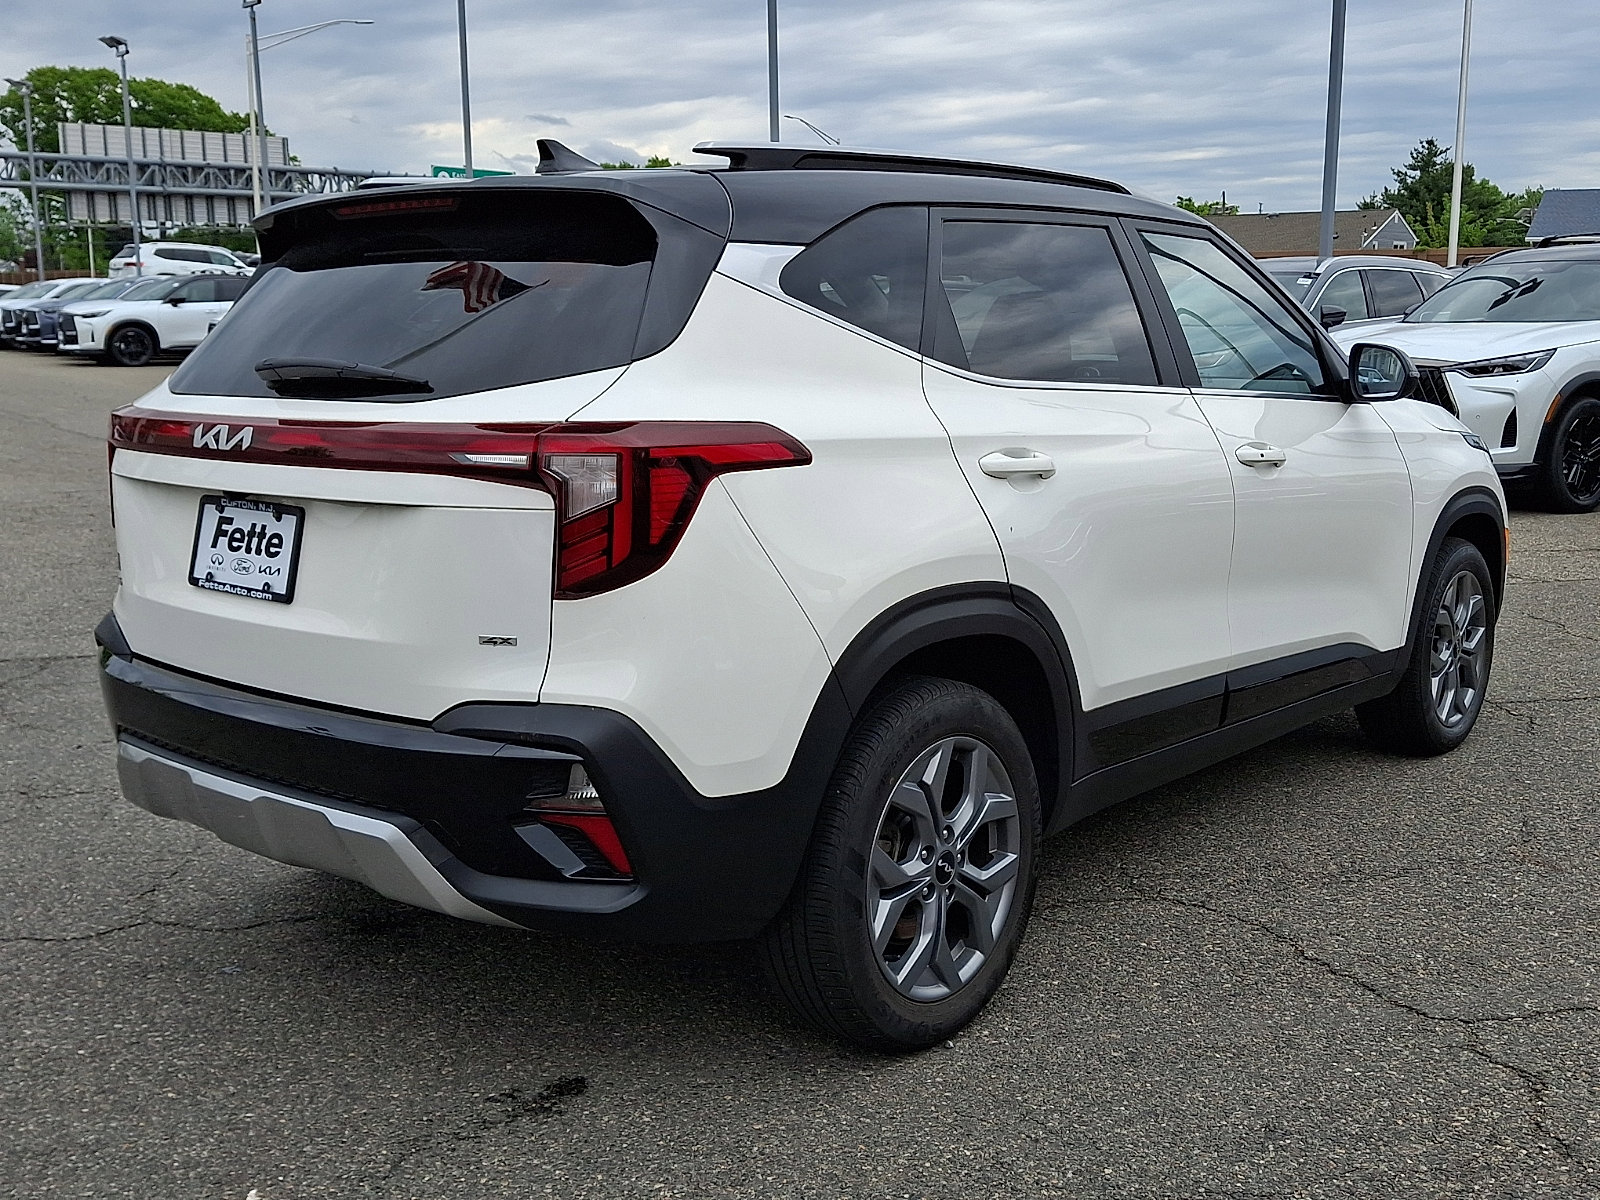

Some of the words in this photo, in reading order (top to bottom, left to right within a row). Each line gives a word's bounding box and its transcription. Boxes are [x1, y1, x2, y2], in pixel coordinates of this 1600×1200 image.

[193, 423, 254, 451] KIA
[210, 515, 284, 559] Fette
[232, 559, 253, 574] Ford
[258, 565, 281, 577] KIA
[198, 579, 273, 601] FetteAuto.com
